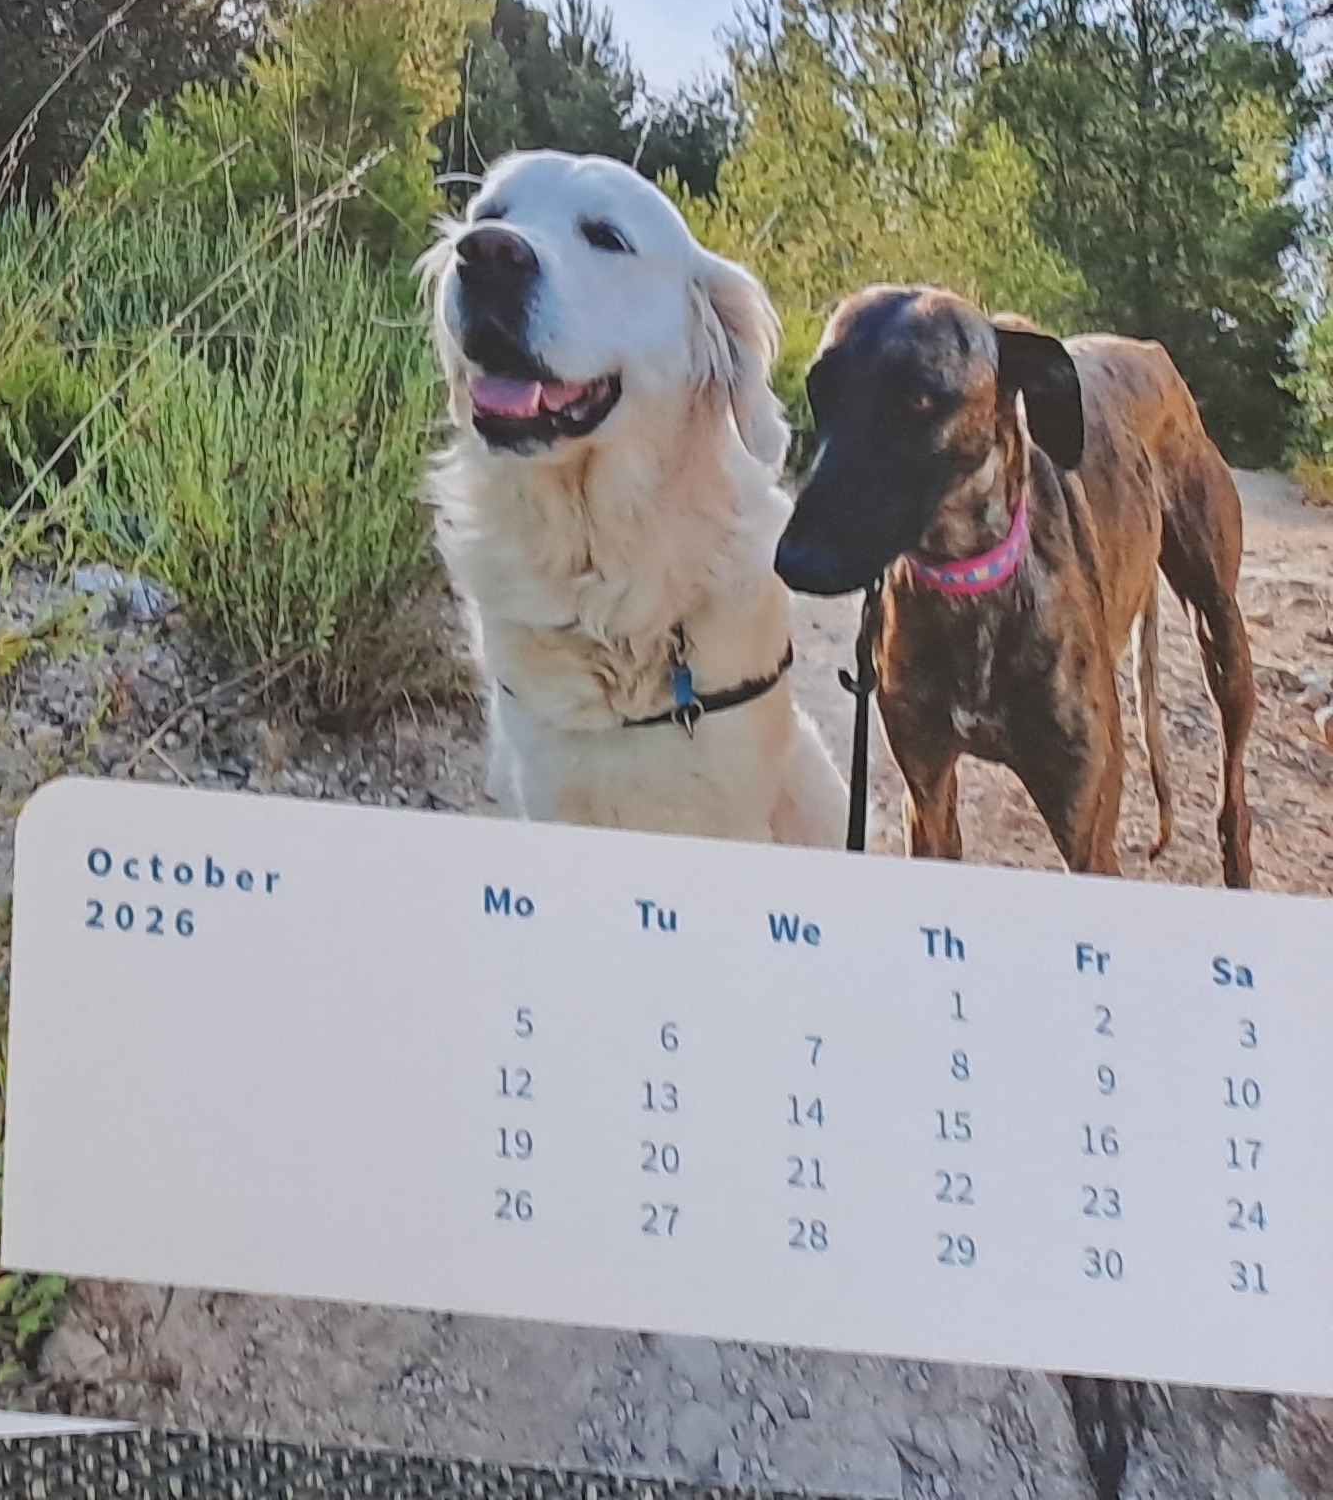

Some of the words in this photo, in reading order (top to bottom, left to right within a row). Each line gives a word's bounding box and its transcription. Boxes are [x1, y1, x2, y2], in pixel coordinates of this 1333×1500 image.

[86, 900, 193, 936] 2026
[88, 848, 280, 893] October
[485, 886, 534, 916] Mo
[636, 900, 676, 931] Tu
[769, 913, 820, 945] We
[920, 927, 965, 960] Th
[1076, 943, 1110, 974] Fr
[1213, 957, 1253, 988] Sa
[496, 1067, 532, 1099] 12
[643, 1080, 679, 1112] 13
[787, 1095, 824, 1127] 14
[936, 1110, 972, 1140] 15
[1084, 1124, 1119, 1156] 16
[1227, 1137, 1262, 1171] 17
[1223, 1076, 1261, 1109] 10
[497, 1127, 533, 1160] 19
[641, 1141, 680, 1174] 20
[787, 1156, 826, 1190] 21
[935, 1171, 974, 1205] 22
[1082, 1185, 1122, 1218] 23
[1227, 1198, 1266, 1231] 24
[493, 1189, 533, 1221] 26
[641, 1203, 680, 1236] 27
[788, 1218, 829, 1251] 28
[937, 1233, 976, 1266] 29
[1084, 1247, 1123, 1281] 30
[1230, 1260, 1268, 1294] 31
